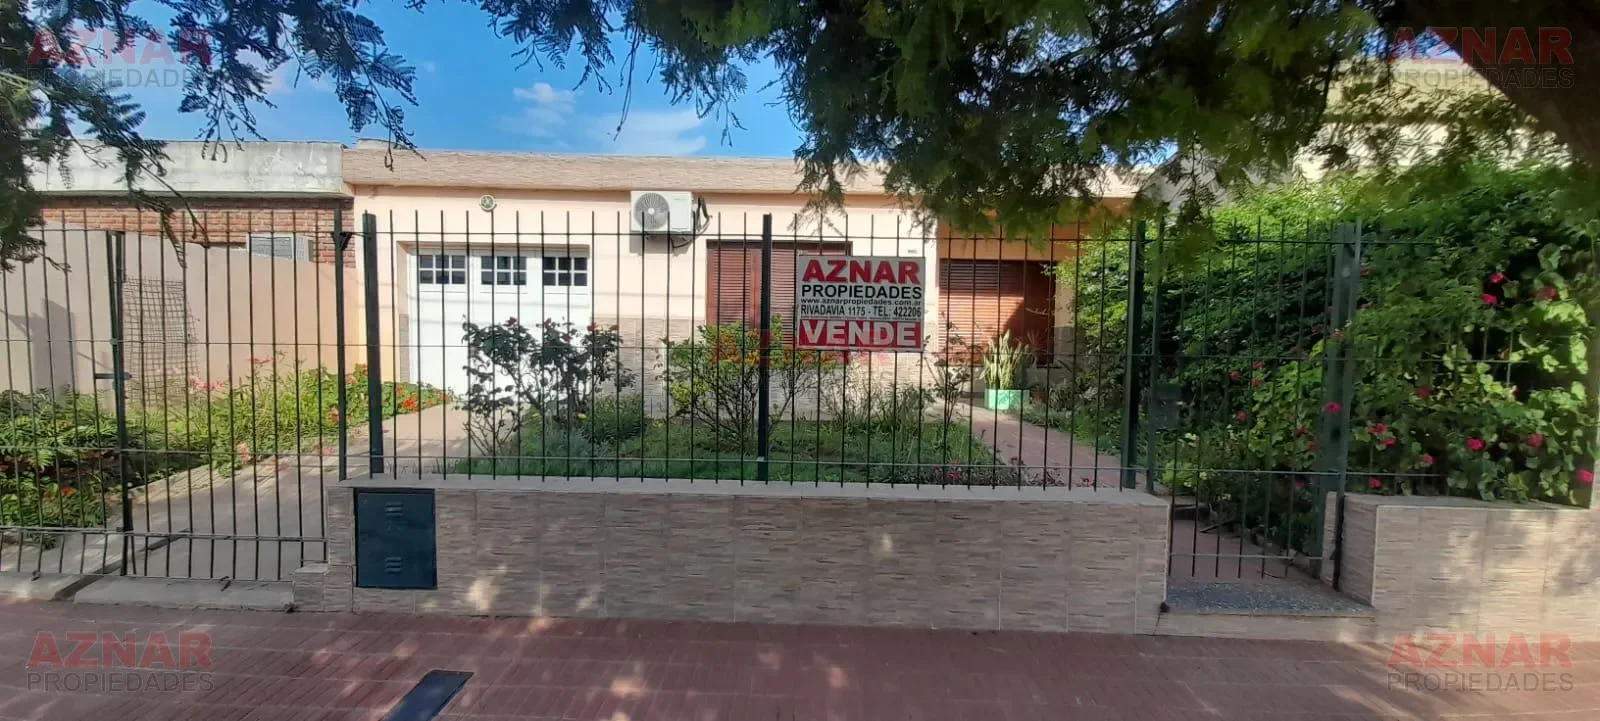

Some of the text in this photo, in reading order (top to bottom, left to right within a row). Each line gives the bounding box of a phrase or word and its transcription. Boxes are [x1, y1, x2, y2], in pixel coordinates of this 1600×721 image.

[802, 259, 921, 284] AZNAR
[801, 284, 922, 299] PROPIEDADES
[800, 298, 921, 306] www.aznarpropiedades.com.ar
[800, 304, 845, 315] RIVADAVIA
[848, 306, 866, 316] 1175
[873, 305, 891, 317] TEL:
[893, 306, 921, 318] 422206
[801, 320, 917, 346] VENDE
